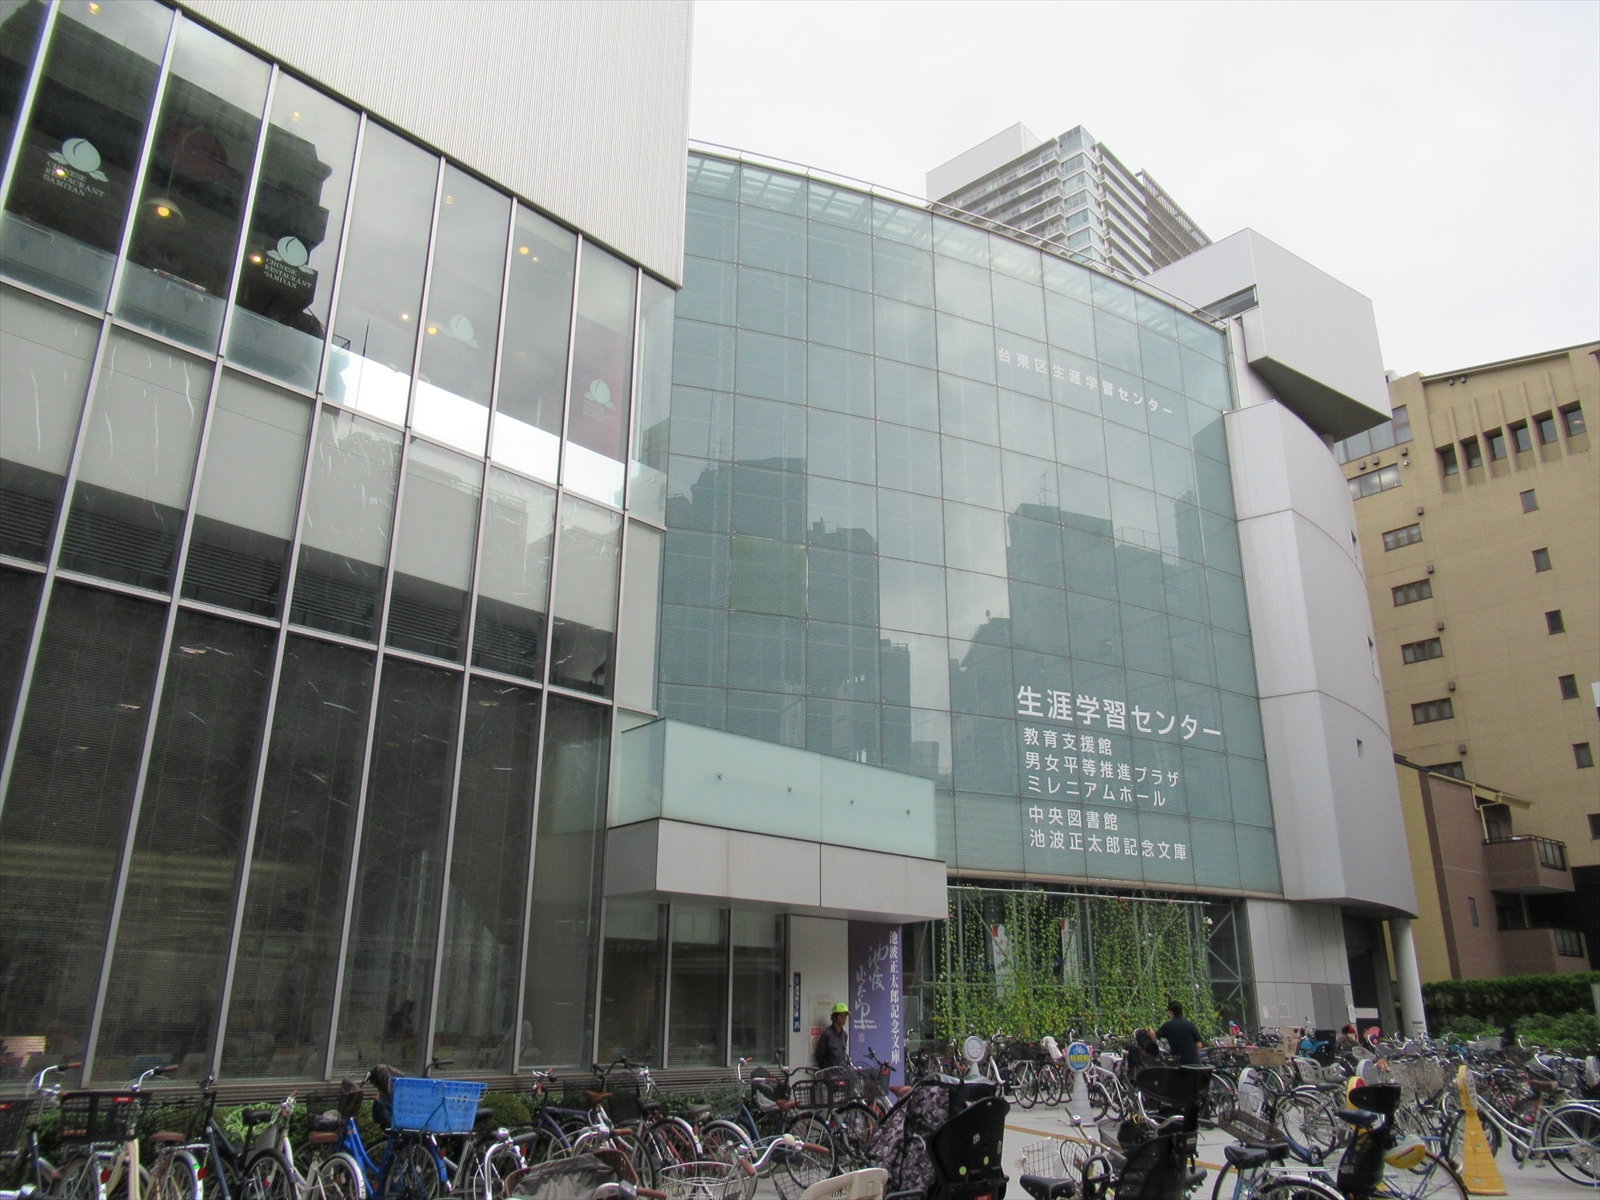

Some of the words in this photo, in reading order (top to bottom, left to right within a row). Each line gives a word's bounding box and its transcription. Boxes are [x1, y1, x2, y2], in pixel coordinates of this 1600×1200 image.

[45, 167, 105, 197] RETAURANT
[265, 264, 312, 289] RESTAURANT
[266, 258, 297, 275] CHINESE
[997, 347, 1173, 414] 台東区生涯学習センター
[1016, 685, 1222, 740] 生涯学習センター
[1023, 727, 1113, 756] 教育支援館
[1025, 751, 1180, 788] 男女平等推進プラザ
[1028, 775, 1166, 807] ミレニアムホール
[1029, 805, 1119, 832] 中央図書館
[1029, 828, 1188, 861] 池波正太郎記念文庫
[889, 930, 900, 1064] 池波正太郎記念文庫
